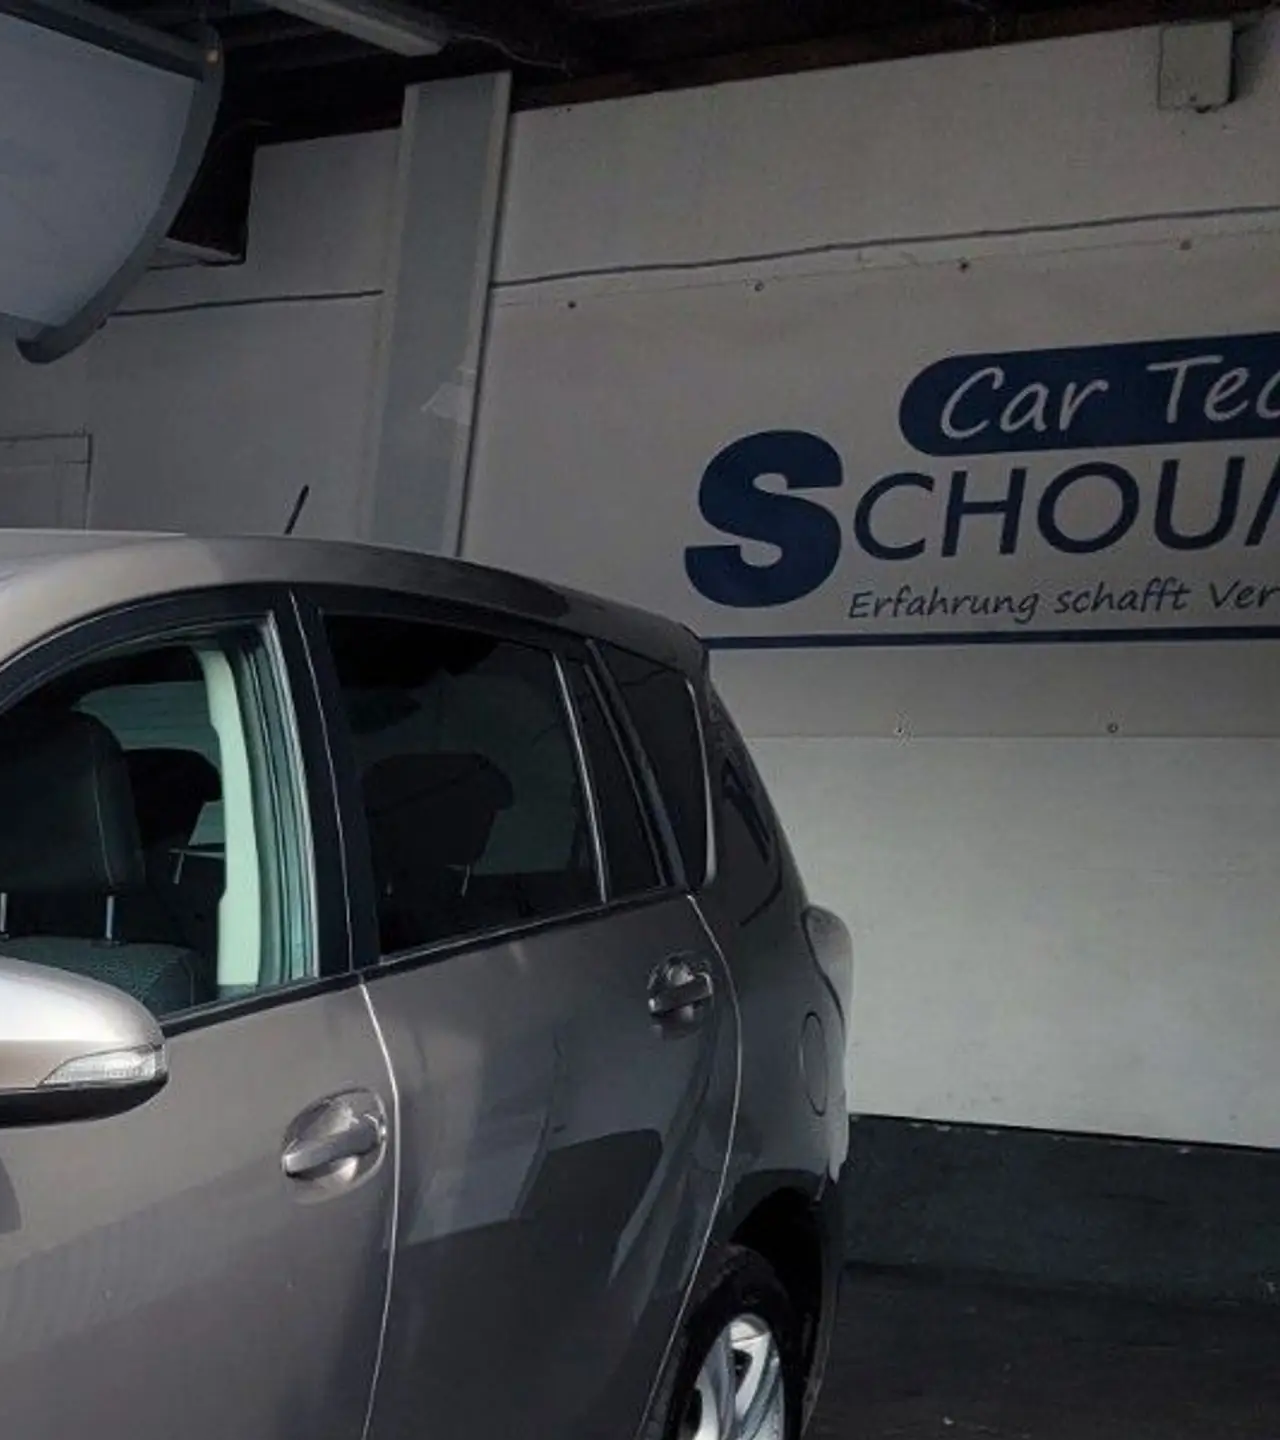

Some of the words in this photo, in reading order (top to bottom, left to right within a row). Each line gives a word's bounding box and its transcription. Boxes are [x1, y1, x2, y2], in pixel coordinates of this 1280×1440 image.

[940, 366, 1109, 440] Car
[848, 581, 1040, 626] Erfahrung
[1053, 577, 1192, 614] schafft
